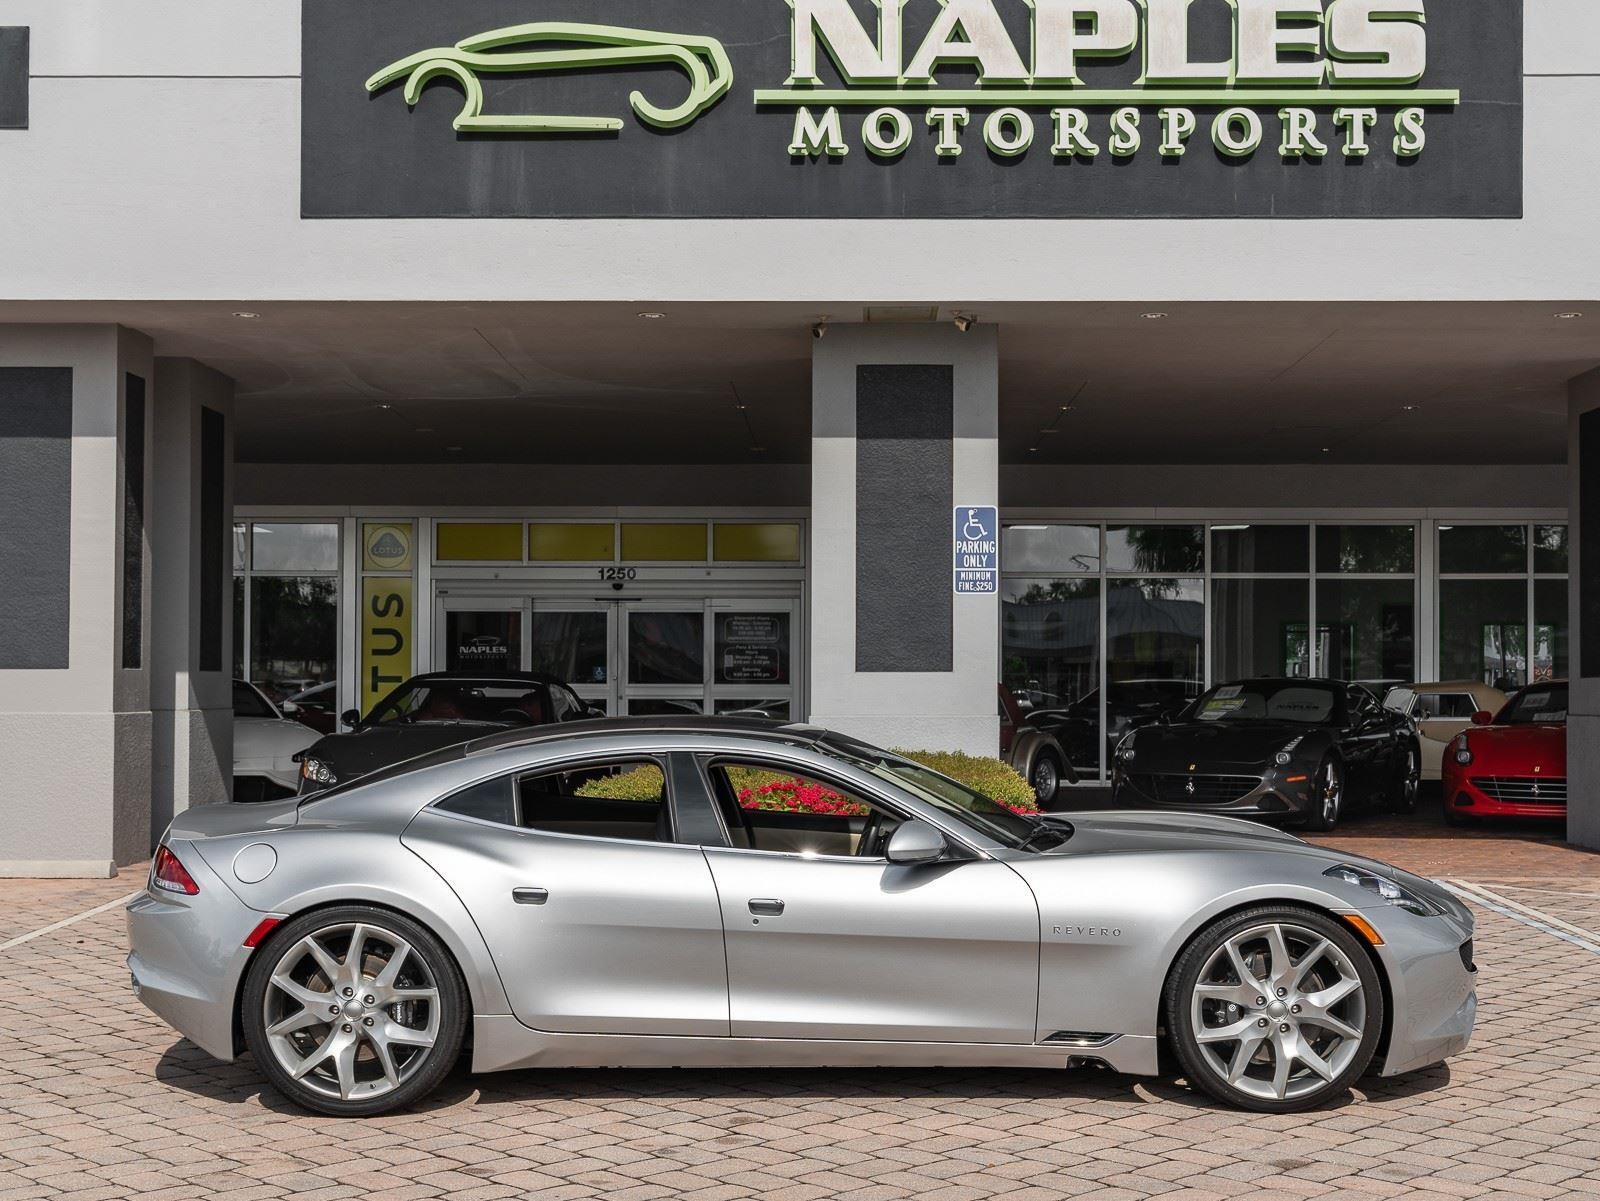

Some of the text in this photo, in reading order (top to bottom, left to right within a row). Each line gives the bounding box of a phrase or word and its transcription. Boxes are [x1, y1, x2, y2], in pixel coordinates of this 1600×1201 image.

[784, 0, 1427, 86] NAPLES
[787, 106, 1427, 157] MOTORSPORTS
[373, 547, 404, 555] LOTUS
[956, 541, 996, 554] PARKING
[963, 555, 988, 567] ONLY
[598, 567, 637, 580] 1250
[960, 571, 991, 581] MINIMUM
[958, 581, 993, 591] FINE $250
[459, 646, 507, 654] NAPLES
[1053, 926, 1121, 937] REVERO
